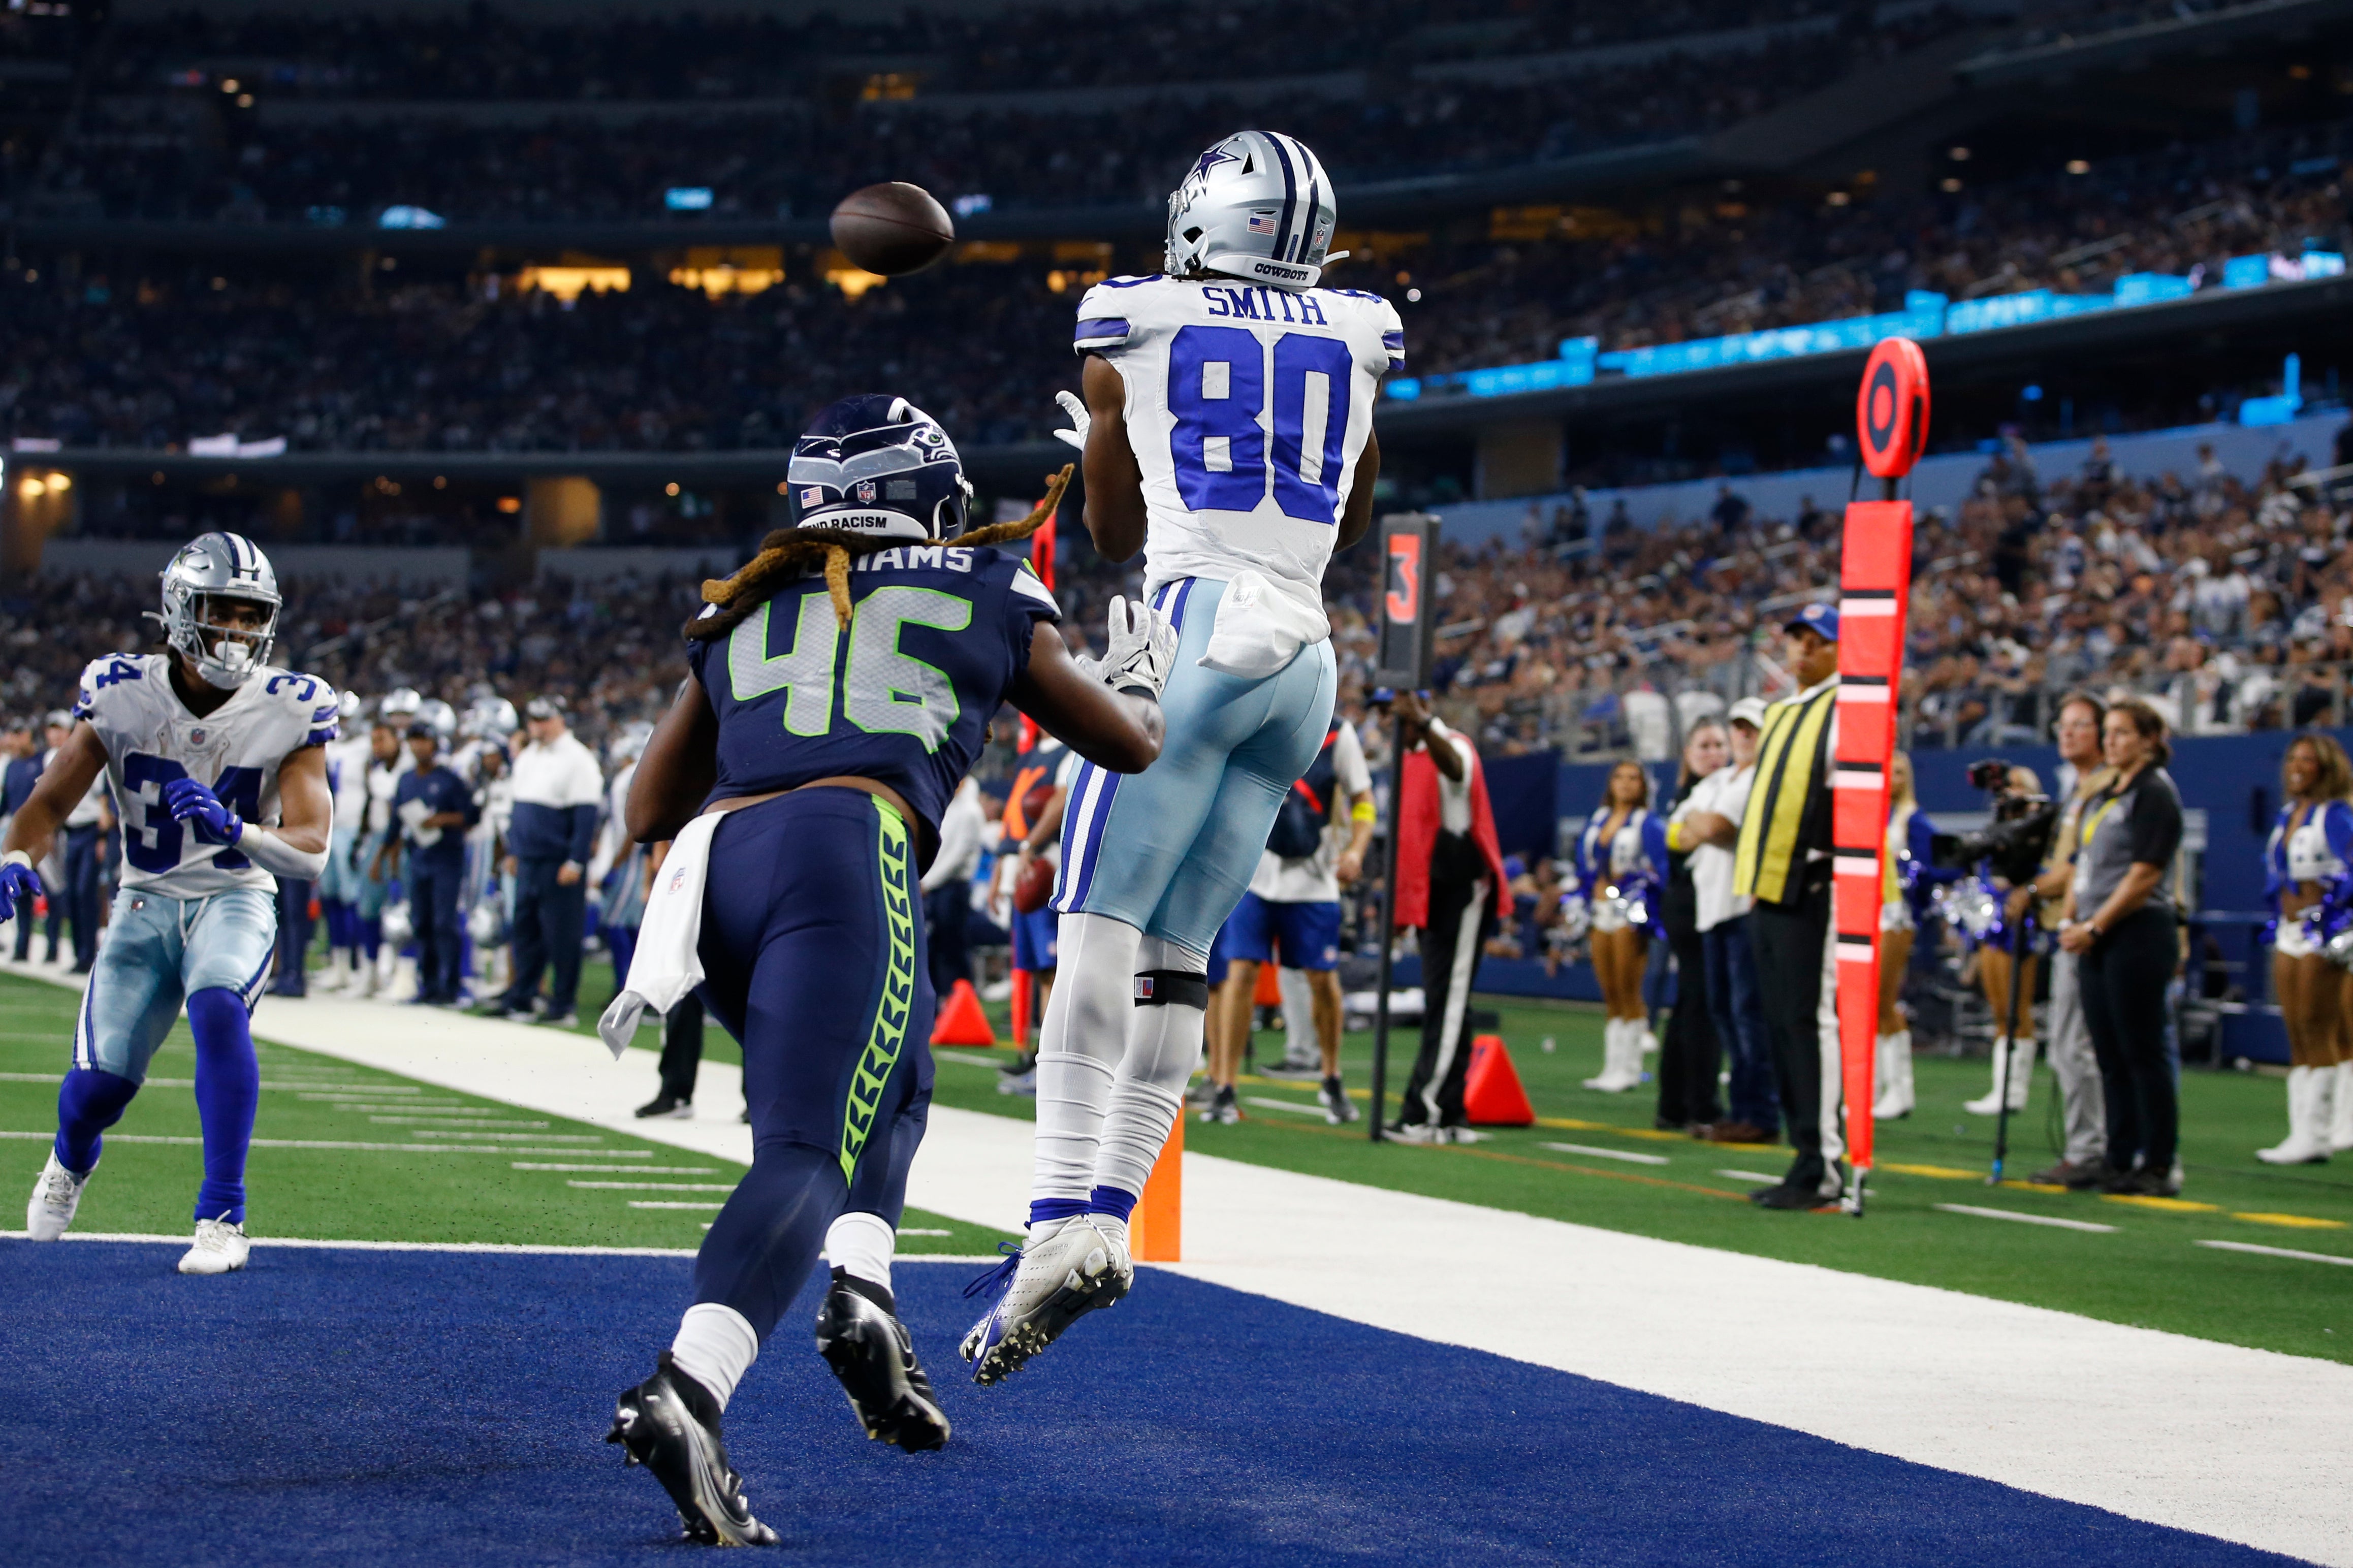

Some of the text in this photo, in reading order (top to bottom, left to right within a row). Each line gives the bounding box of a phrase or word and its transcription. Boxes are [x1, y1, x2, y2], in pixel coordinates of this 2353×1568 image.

[1202, 285, 1327, 325] SMITH
[1254, 263, 1308, 280] COWBOYS
[1168, 325, 1353, 525] 80
[831, 516, 887, 529] RACISM
[1386, 533, 1421, 625] 3
[728, 586, 973, 754] 46
[123, 752, 264, 874] 34
